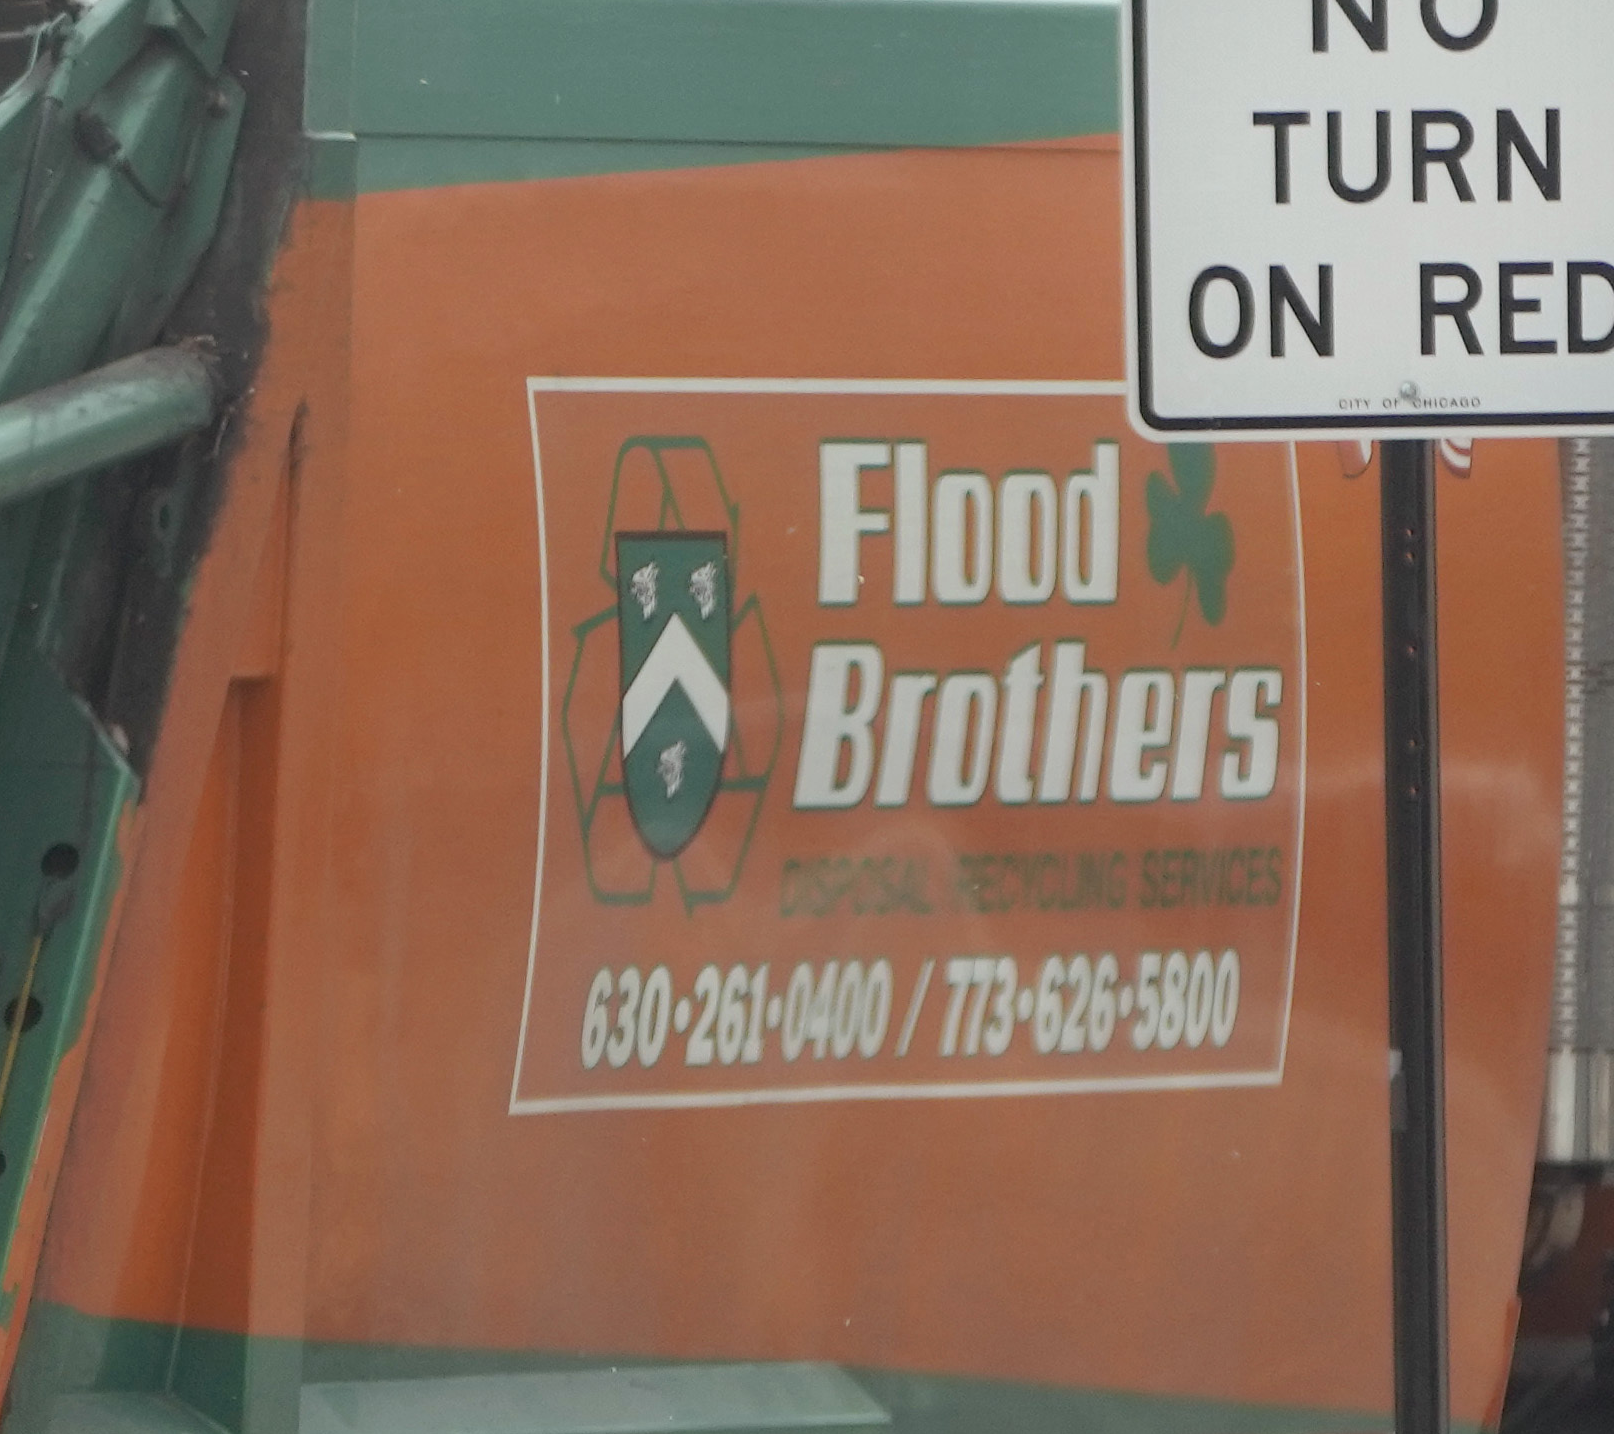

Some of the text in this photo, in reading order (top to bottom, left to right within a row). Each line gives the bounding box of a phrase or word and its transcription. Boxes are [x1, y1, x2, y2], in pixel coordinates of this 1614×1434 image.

[1252, 108, 1561, 204] TURN
[1188, 263, 1335, 359] ON
[1338, 398, 1371, 410] CITY
[1412, 396, 1481, 410] CHICAGO
[817, 439, 1121, 607] Flood
[793, 640, 1283, 812] Brothers
[780, 846, 1282, 918] DISPOSAL RECYCLING SERVICES
